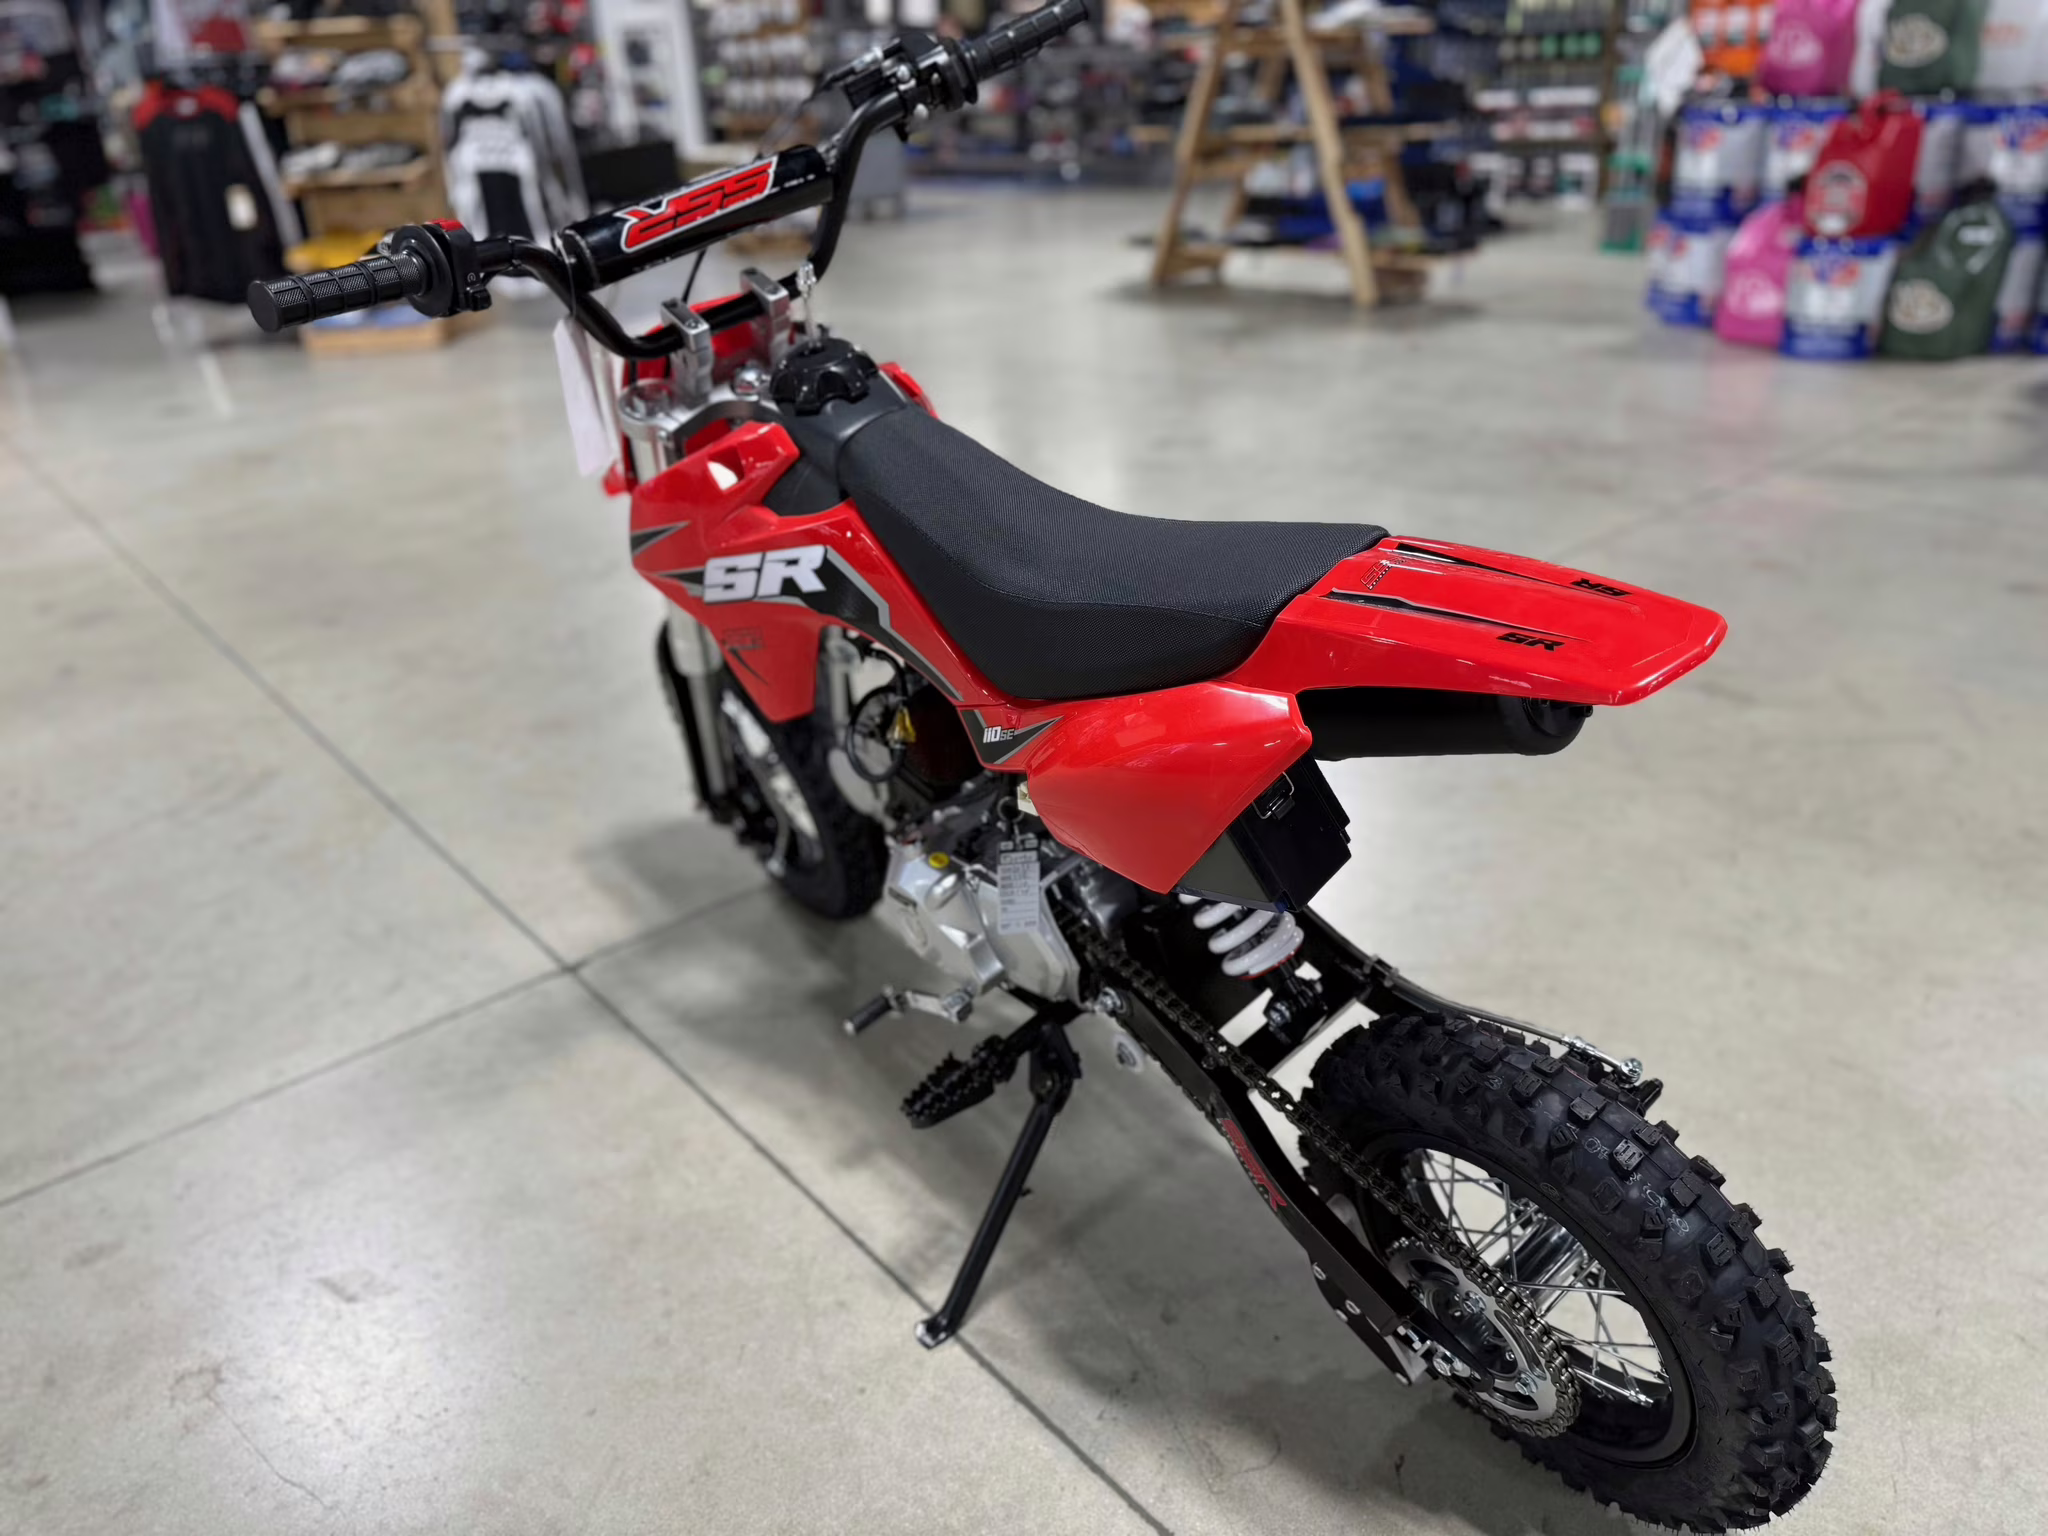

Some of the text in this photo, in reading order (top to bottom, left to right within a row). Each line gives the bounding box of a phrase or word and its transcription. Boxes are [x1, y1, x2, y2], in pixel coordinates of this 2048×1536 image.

[615, 156, 778, 252] SSR
[704, 545, 827, 603] SR
[1497, 632, 1566, 651] SR
